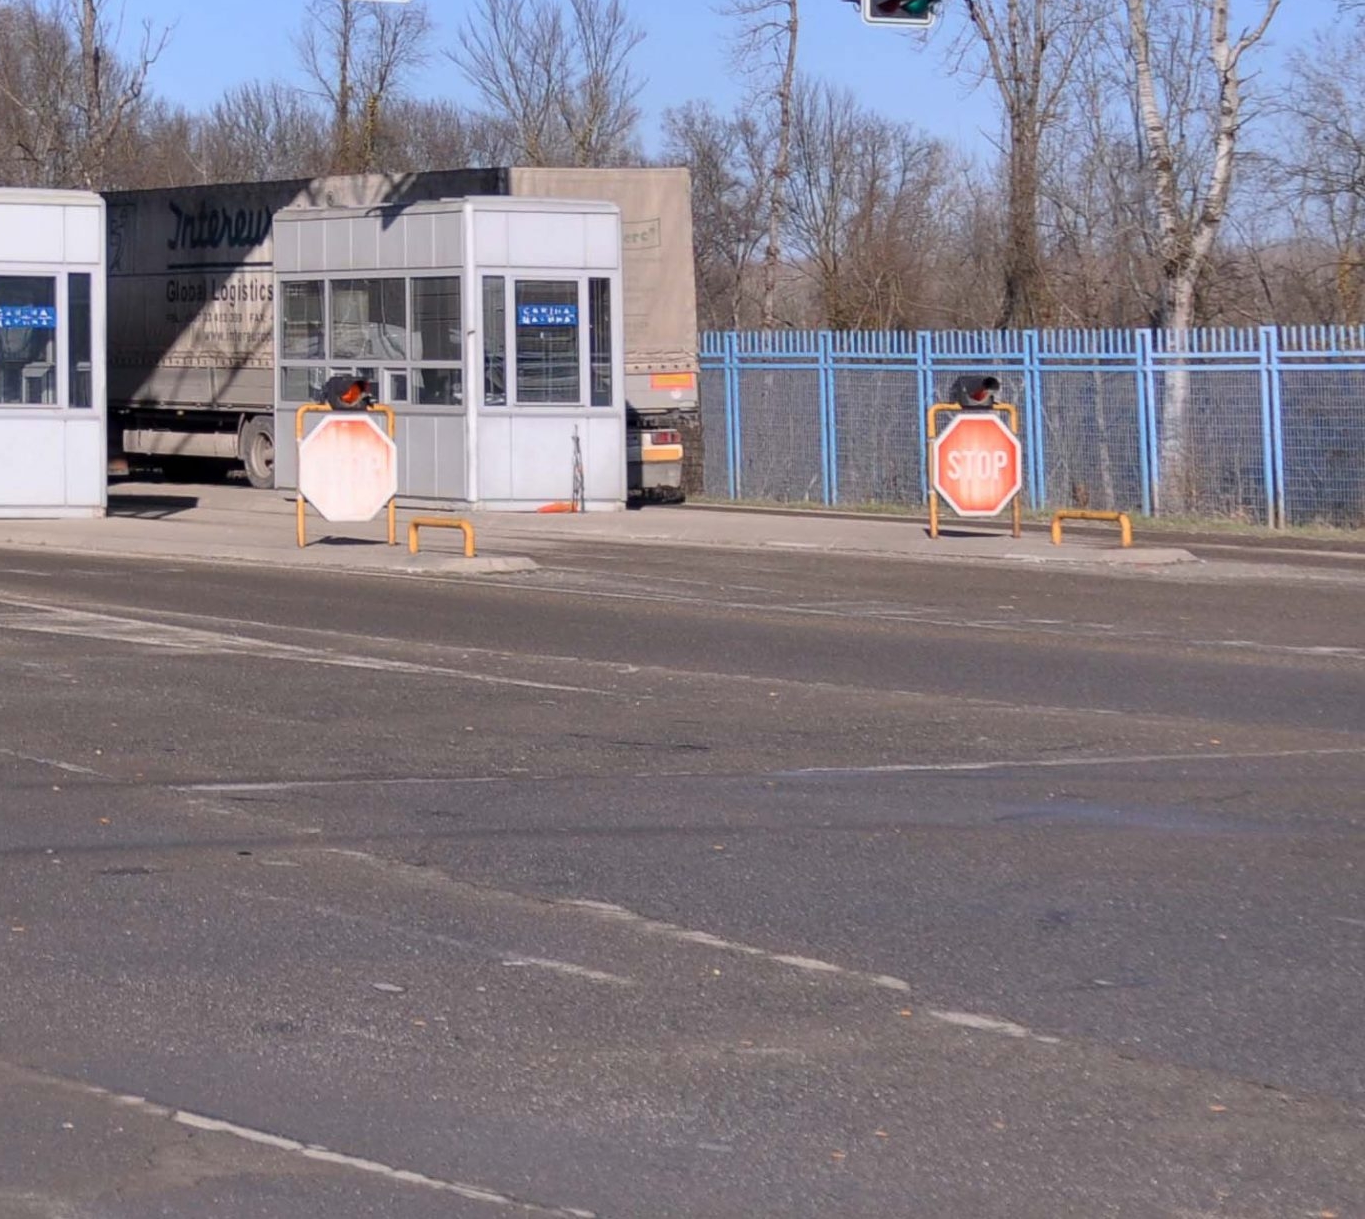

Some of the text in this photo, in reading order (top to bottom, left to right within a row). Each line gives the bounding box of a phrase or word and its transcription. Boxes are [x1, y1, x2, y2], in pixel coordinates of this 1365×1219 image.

[167, 280, 273, 307] Global Logistics
[523, 316, 571, 325] ЦАИНА
[947, 450, 1008, 480] STOP
